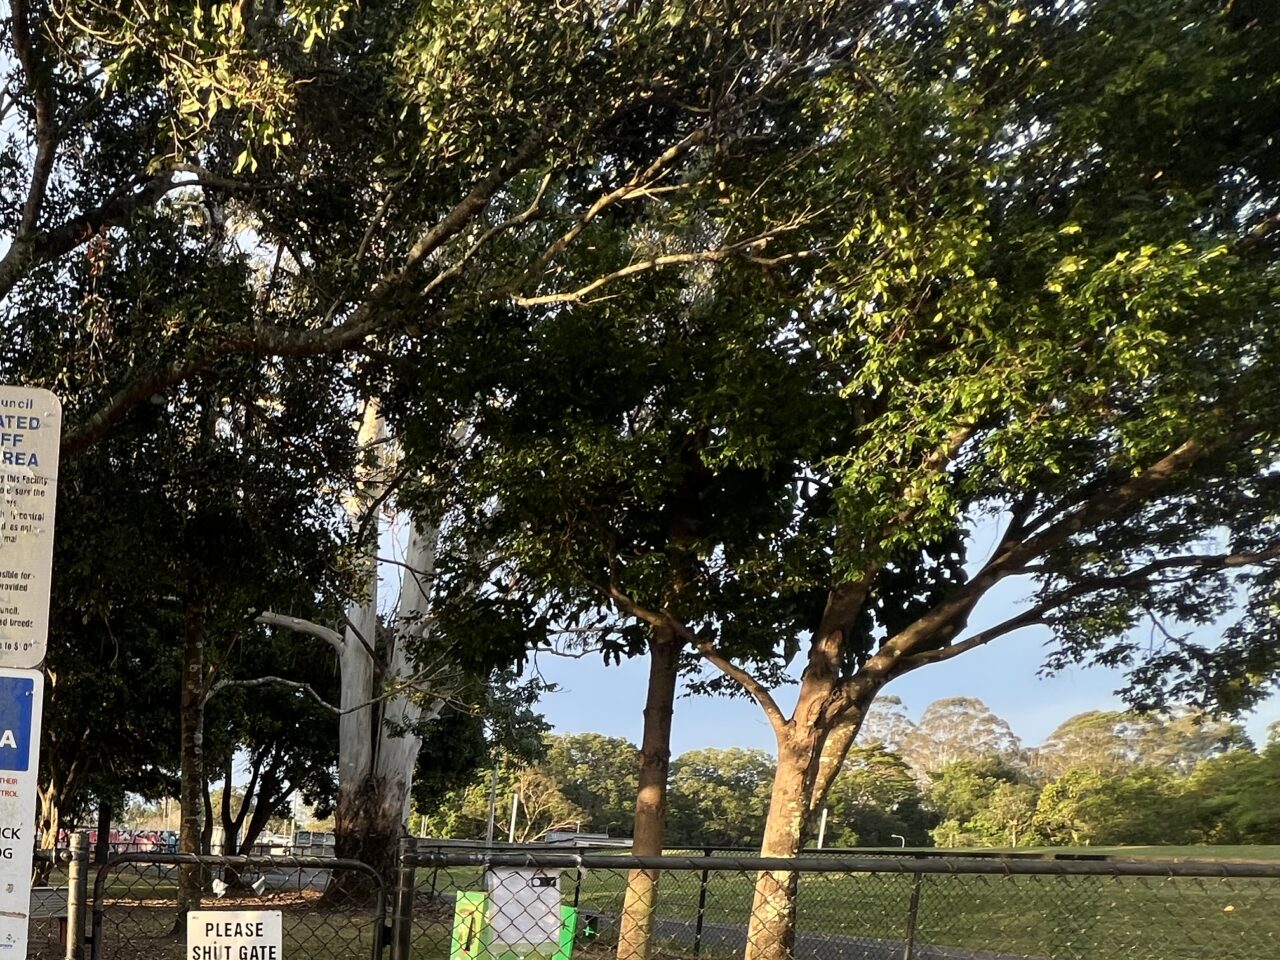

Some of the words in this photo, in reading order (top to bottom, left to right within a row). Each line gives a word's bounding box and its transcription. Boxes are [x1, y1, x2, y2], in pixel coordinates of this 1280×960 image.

[7, 475, 20, 483] this
[6, 488, 31, 496] esure
[1, 523, 18, 531] des
[5, 642, 11, 650] to
[206, 923, 263, 937] PLEASE
[192, 946, 231, 960] SHUT
[239, 946, 276, 960] GATE
